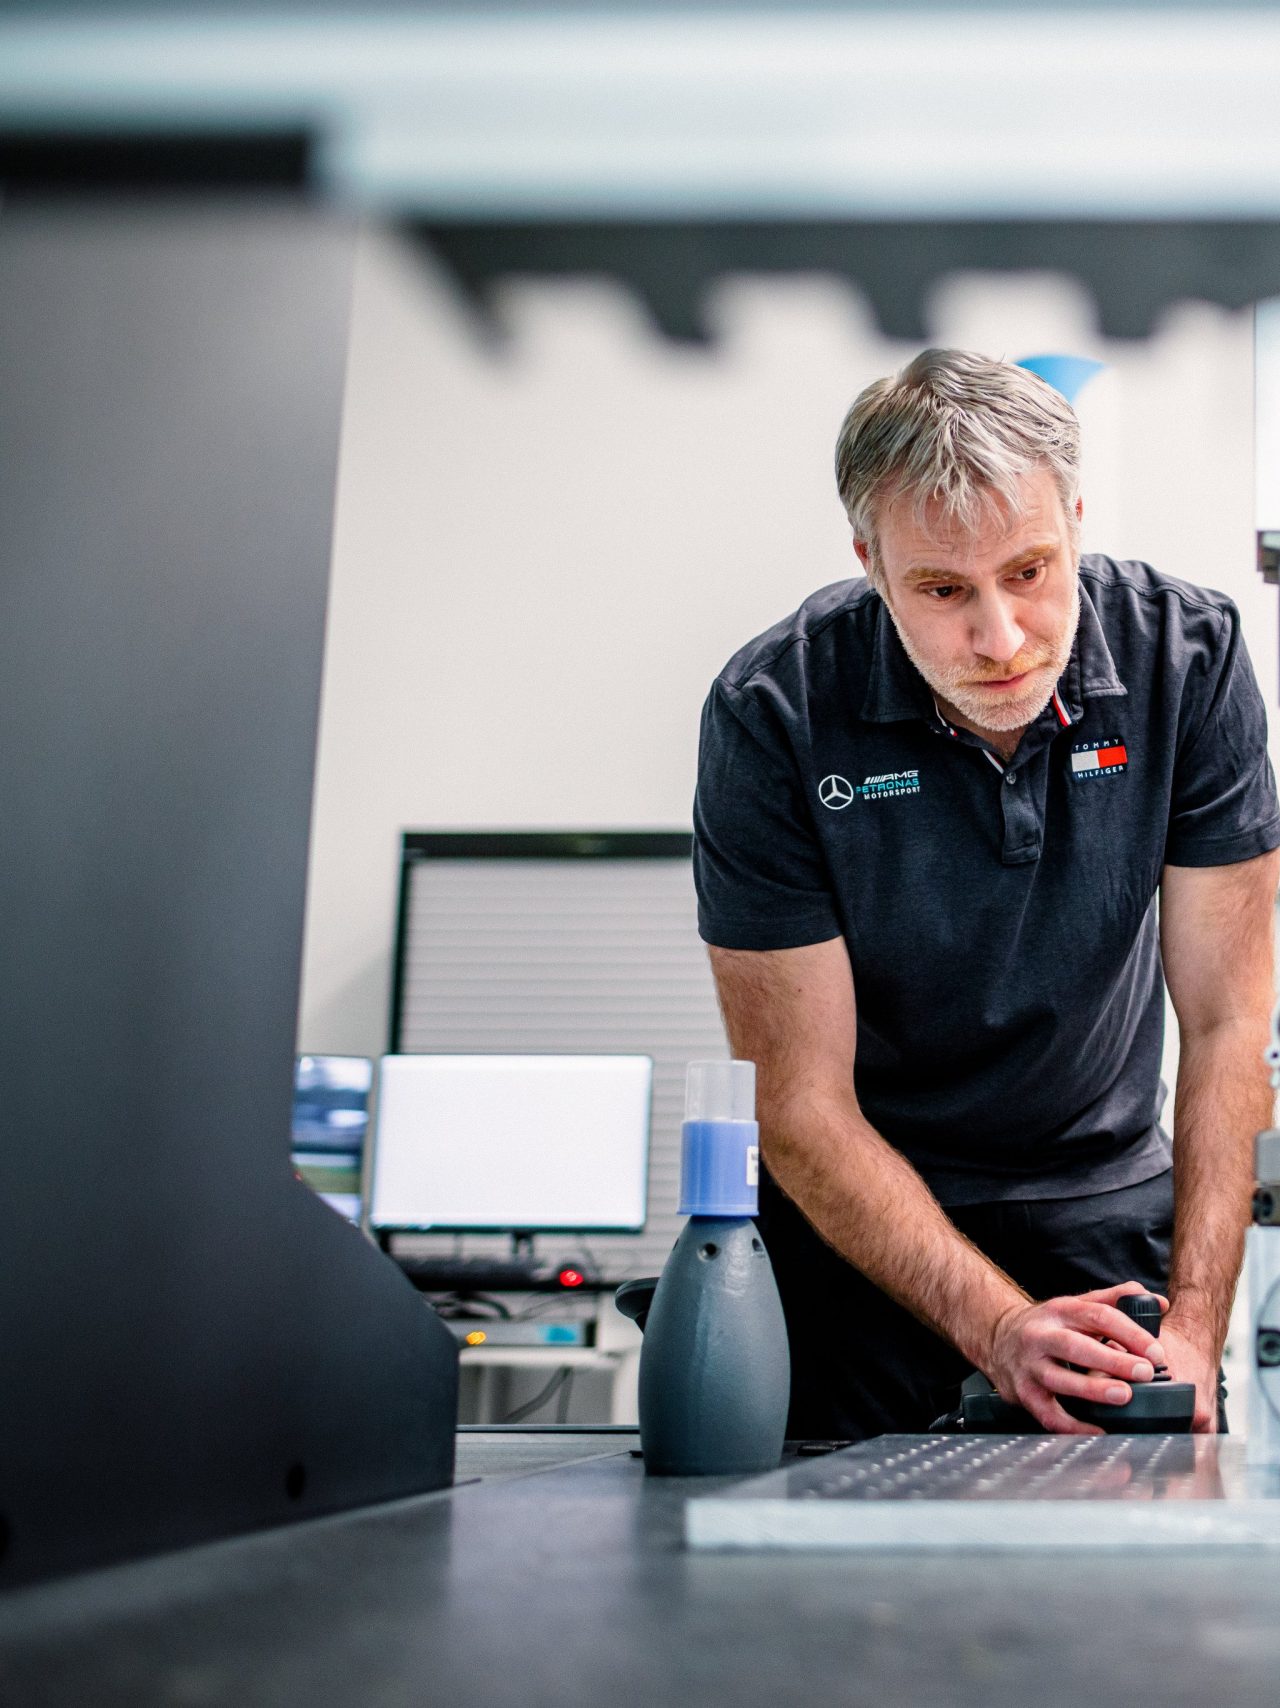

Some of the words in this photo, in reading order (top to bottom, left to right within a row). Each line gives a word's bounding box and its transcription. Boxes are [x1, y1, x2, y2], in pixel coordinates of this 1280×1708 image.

[1075, 739, 1119, 751] TOMMY
[1077, 765, 1124, 778] HILFIGER
[856, 778, 919, 794] PETRONAS
[864, 786, 920, 800] MOTORSPORT
